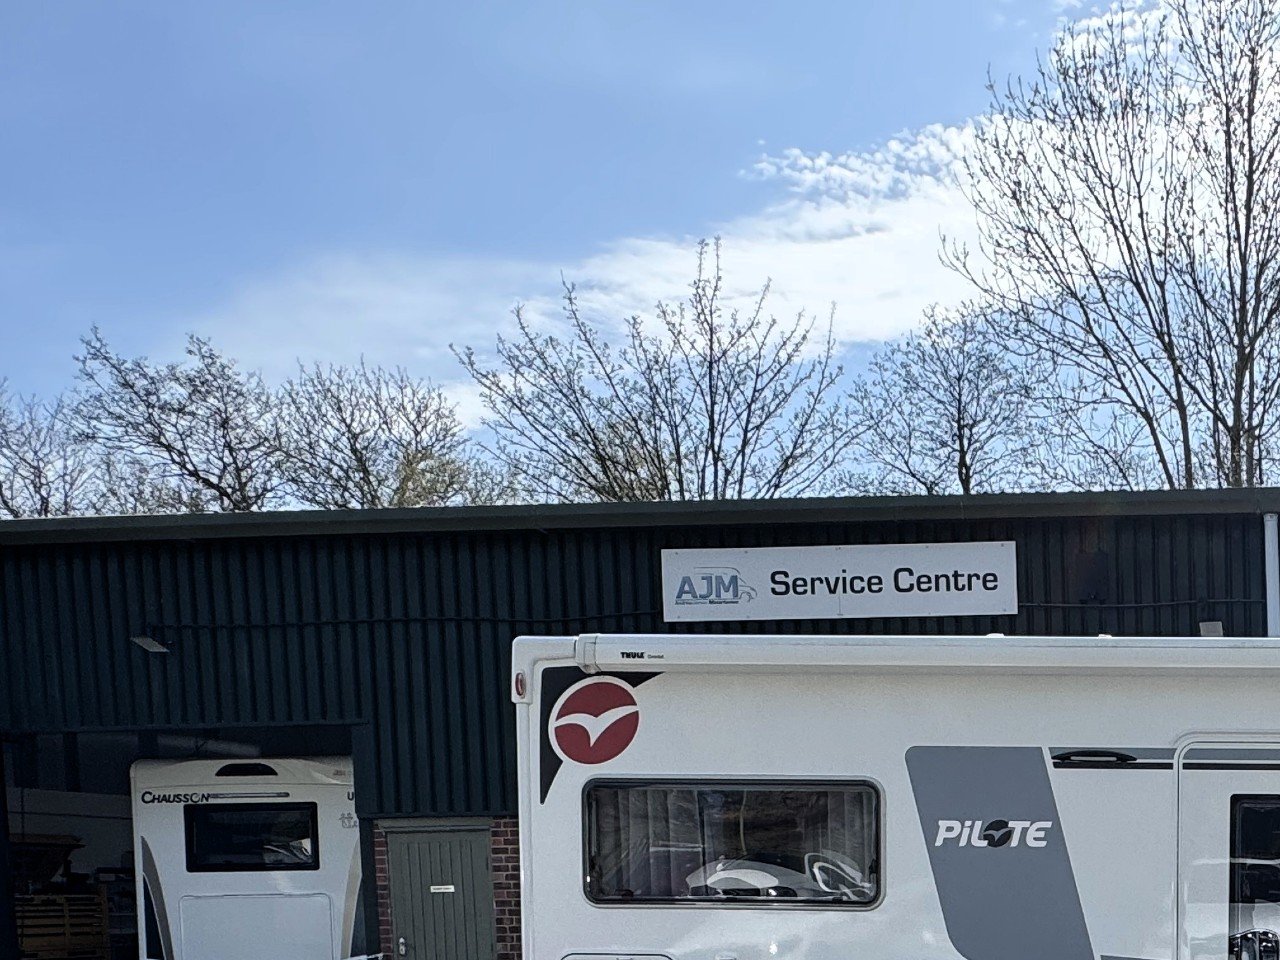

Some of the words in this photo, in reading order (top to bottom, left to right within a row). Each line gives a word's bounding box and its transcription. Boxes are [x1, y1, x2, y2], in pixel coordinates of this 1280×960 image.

[675, 574, 739, 600] AJM
[770, 569, 883, 595] Service
[893, 567, 998, 593] Centre
